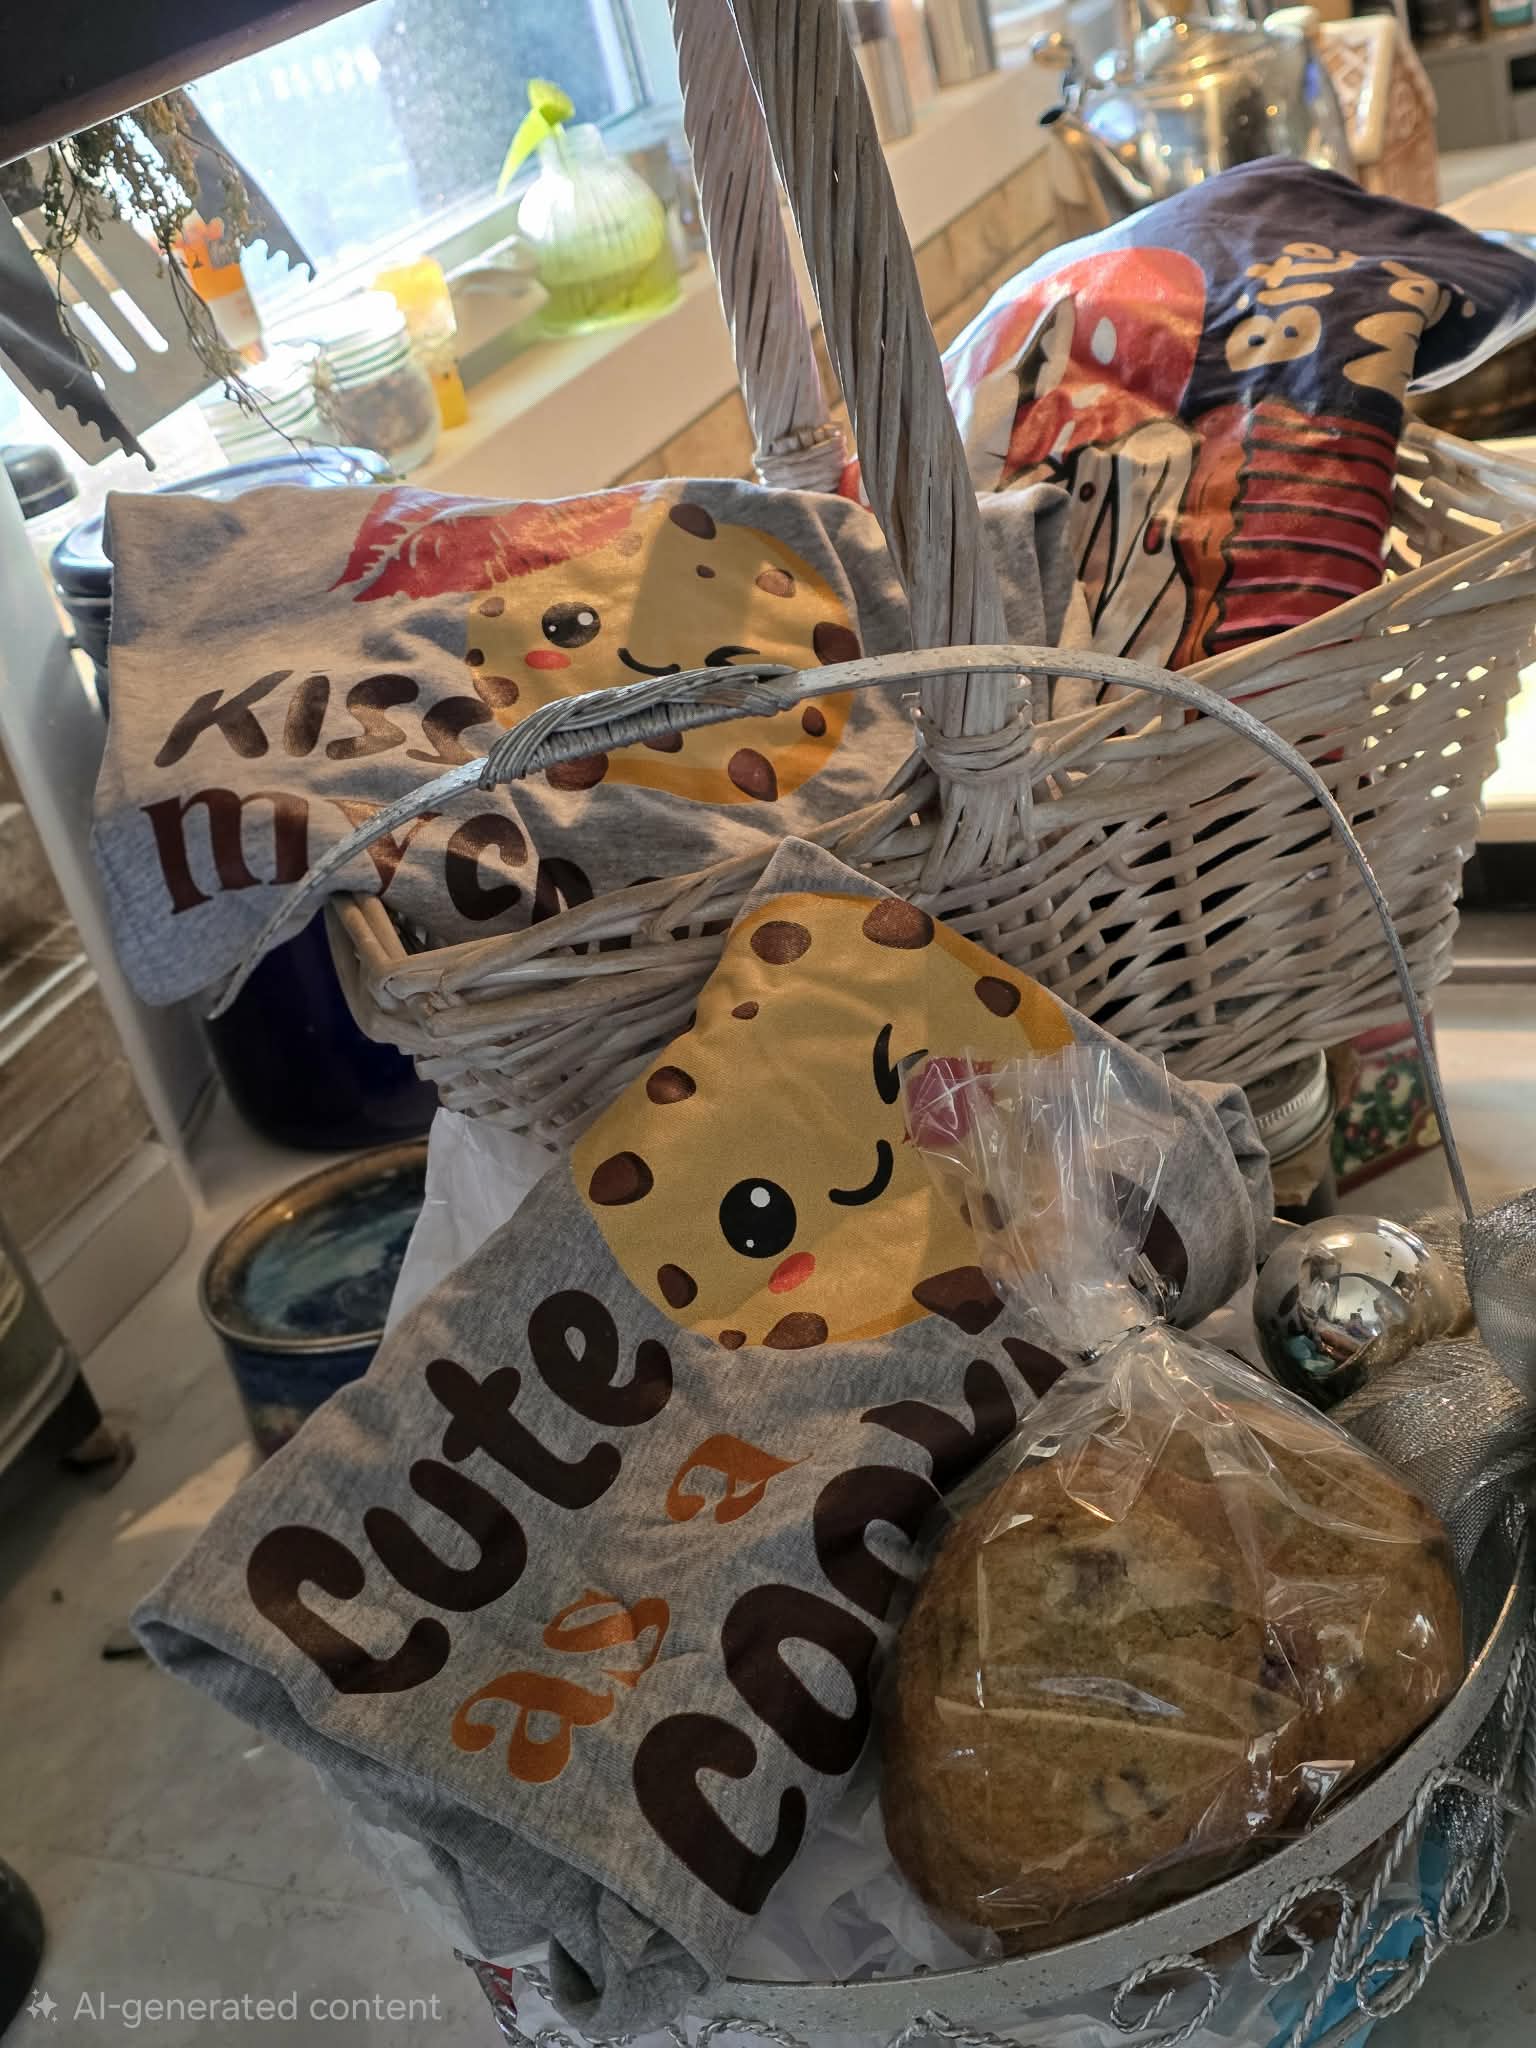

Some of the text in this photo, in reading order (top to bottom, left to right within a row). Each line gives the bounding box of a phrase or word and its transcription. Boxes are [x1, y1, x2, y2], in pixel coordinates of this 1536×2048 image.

[1225, 241, 1361, 372] Bite
[246, 1289, 674, 1695] Cute
[450, 1433, 813, 1785] as a
